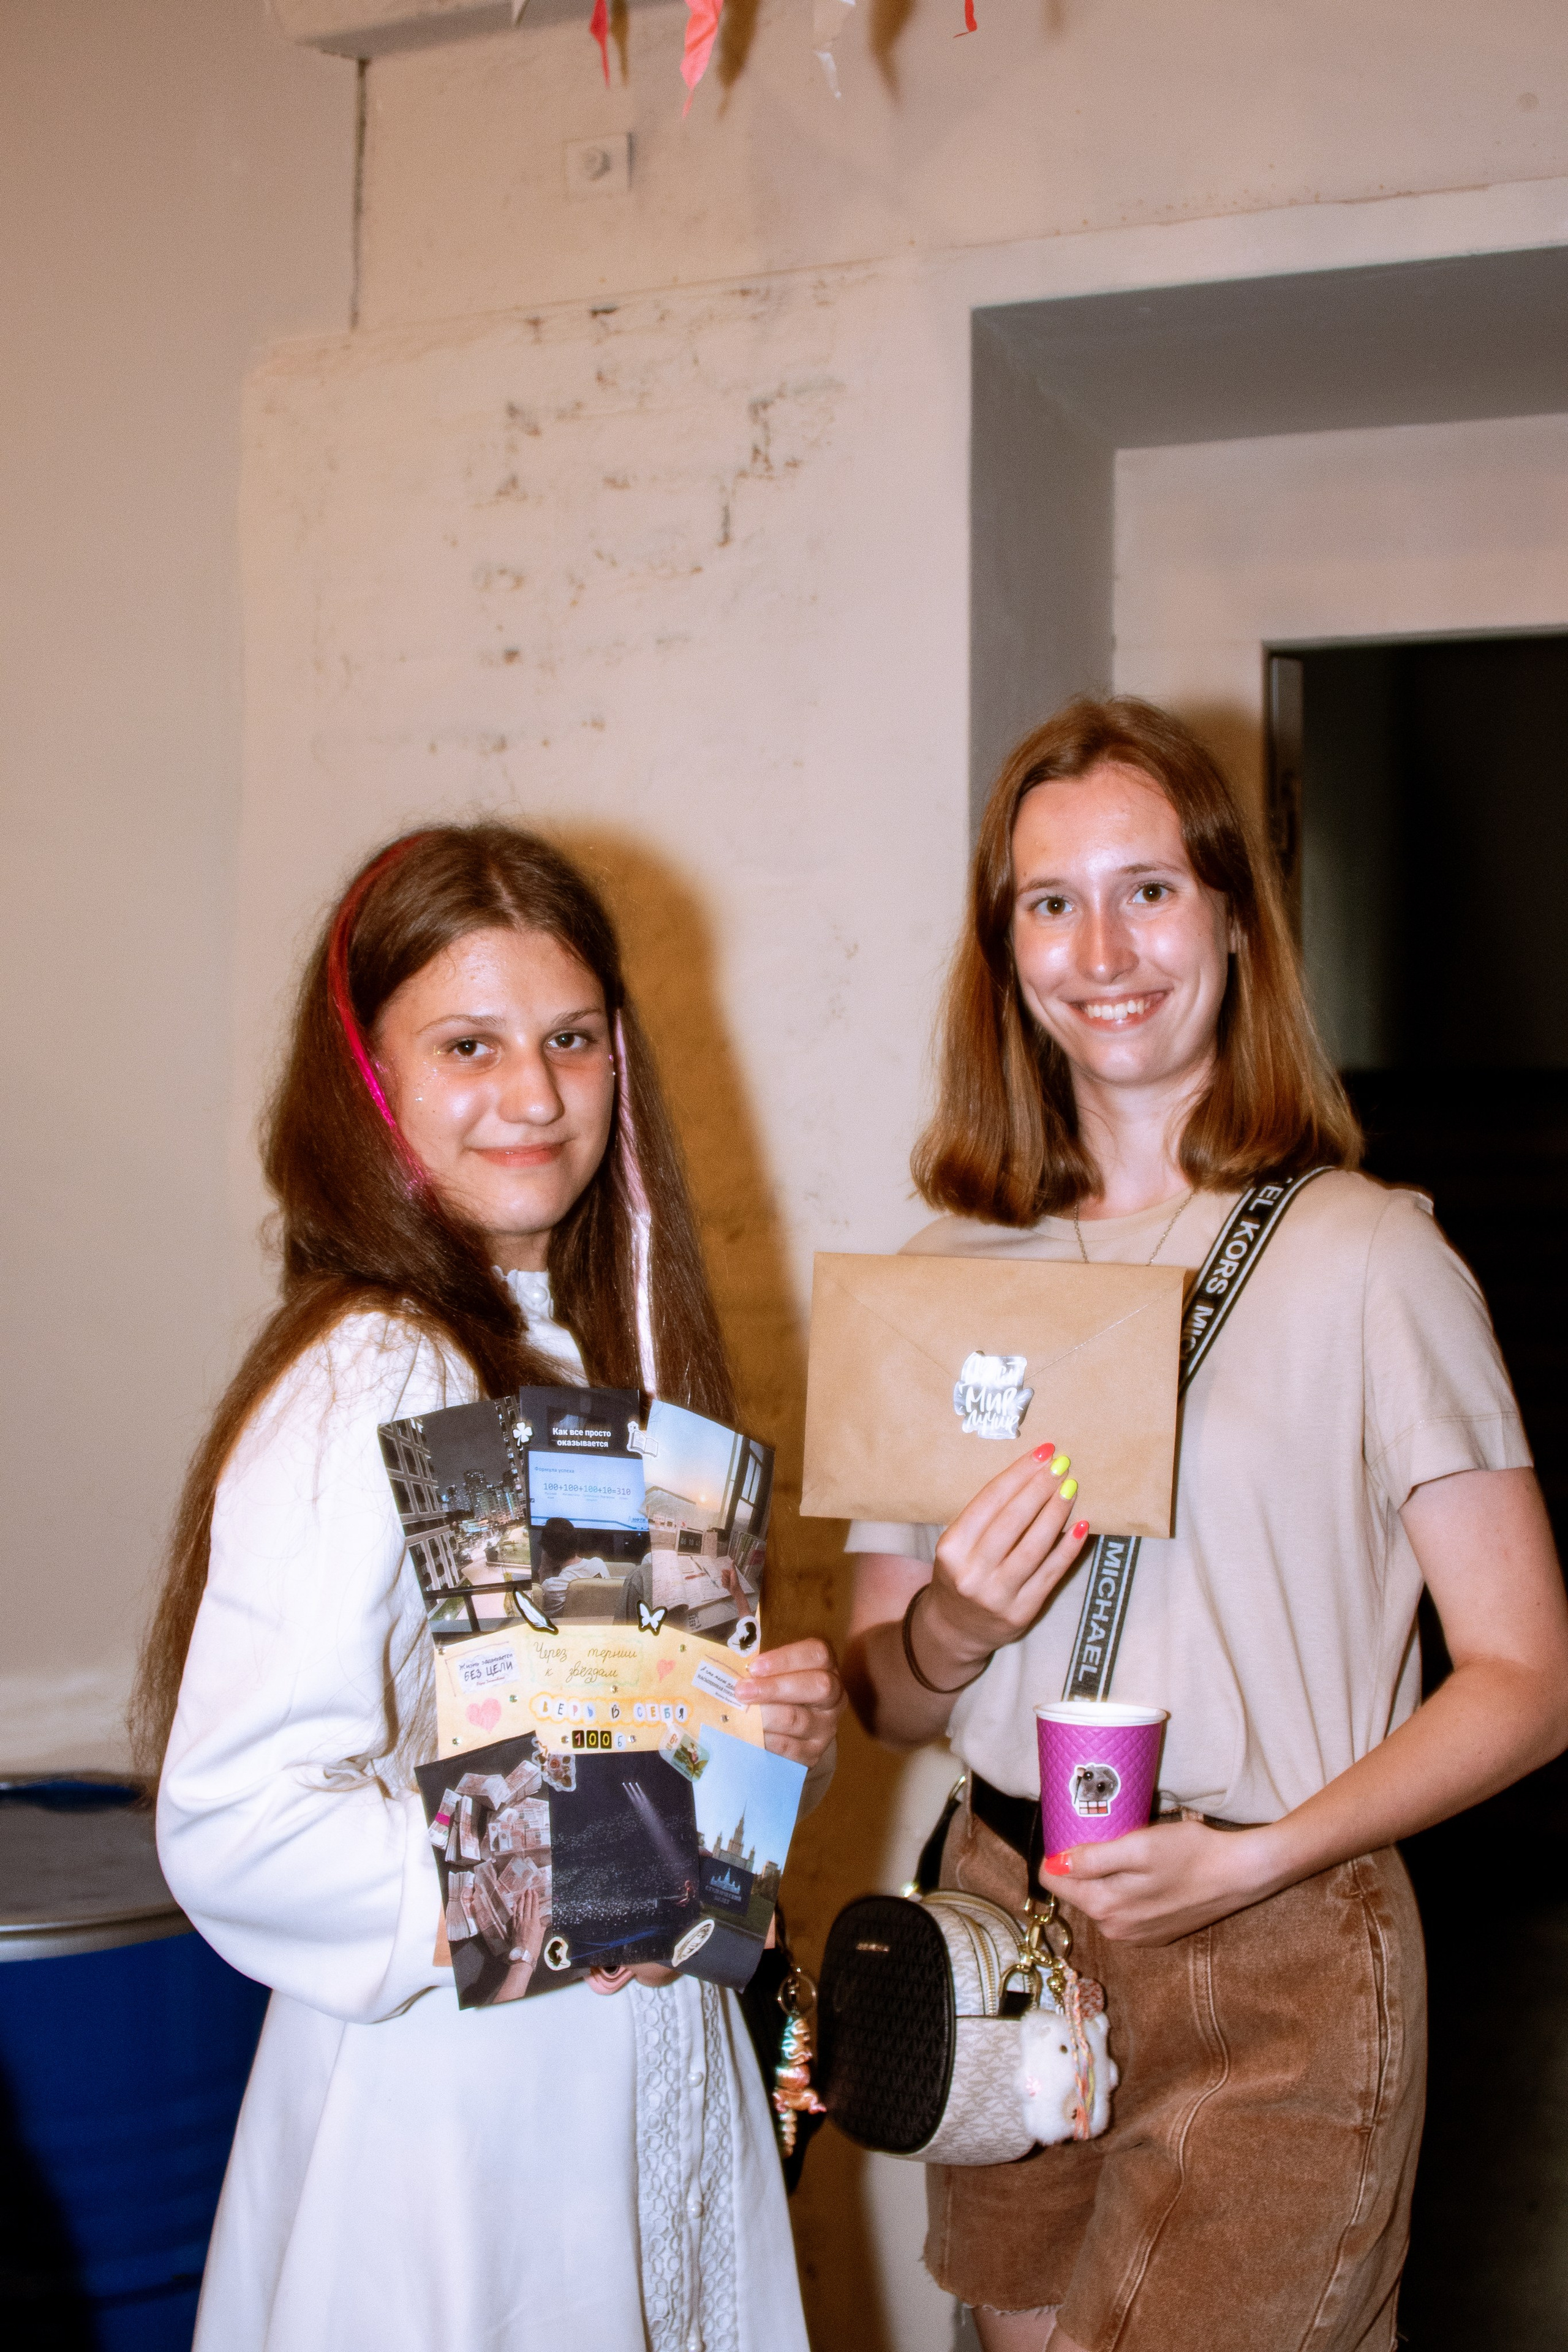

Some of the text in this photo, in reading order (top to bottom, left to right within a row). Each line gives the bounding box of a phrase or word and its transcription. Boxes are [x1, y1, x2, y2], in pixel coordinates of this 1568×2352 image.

[1249, 1177, 1293, 1211] EL
[1205, 1220, 1261, 1295] KORS
[552, 1427, 568, 1436] Как
[1078, 1541, 1125, 1682] MICHAEL
[533, 1642, 637, 1663] Через тернии
[464, 1669, 481, 1682] БЕЗ
[486, 1661, 513, 1676] ЦЕЛИ
[545, 1668, 553, 1676] к
[543, 1701, 684, 1719] ВЕРЬ В СЕБЯ
